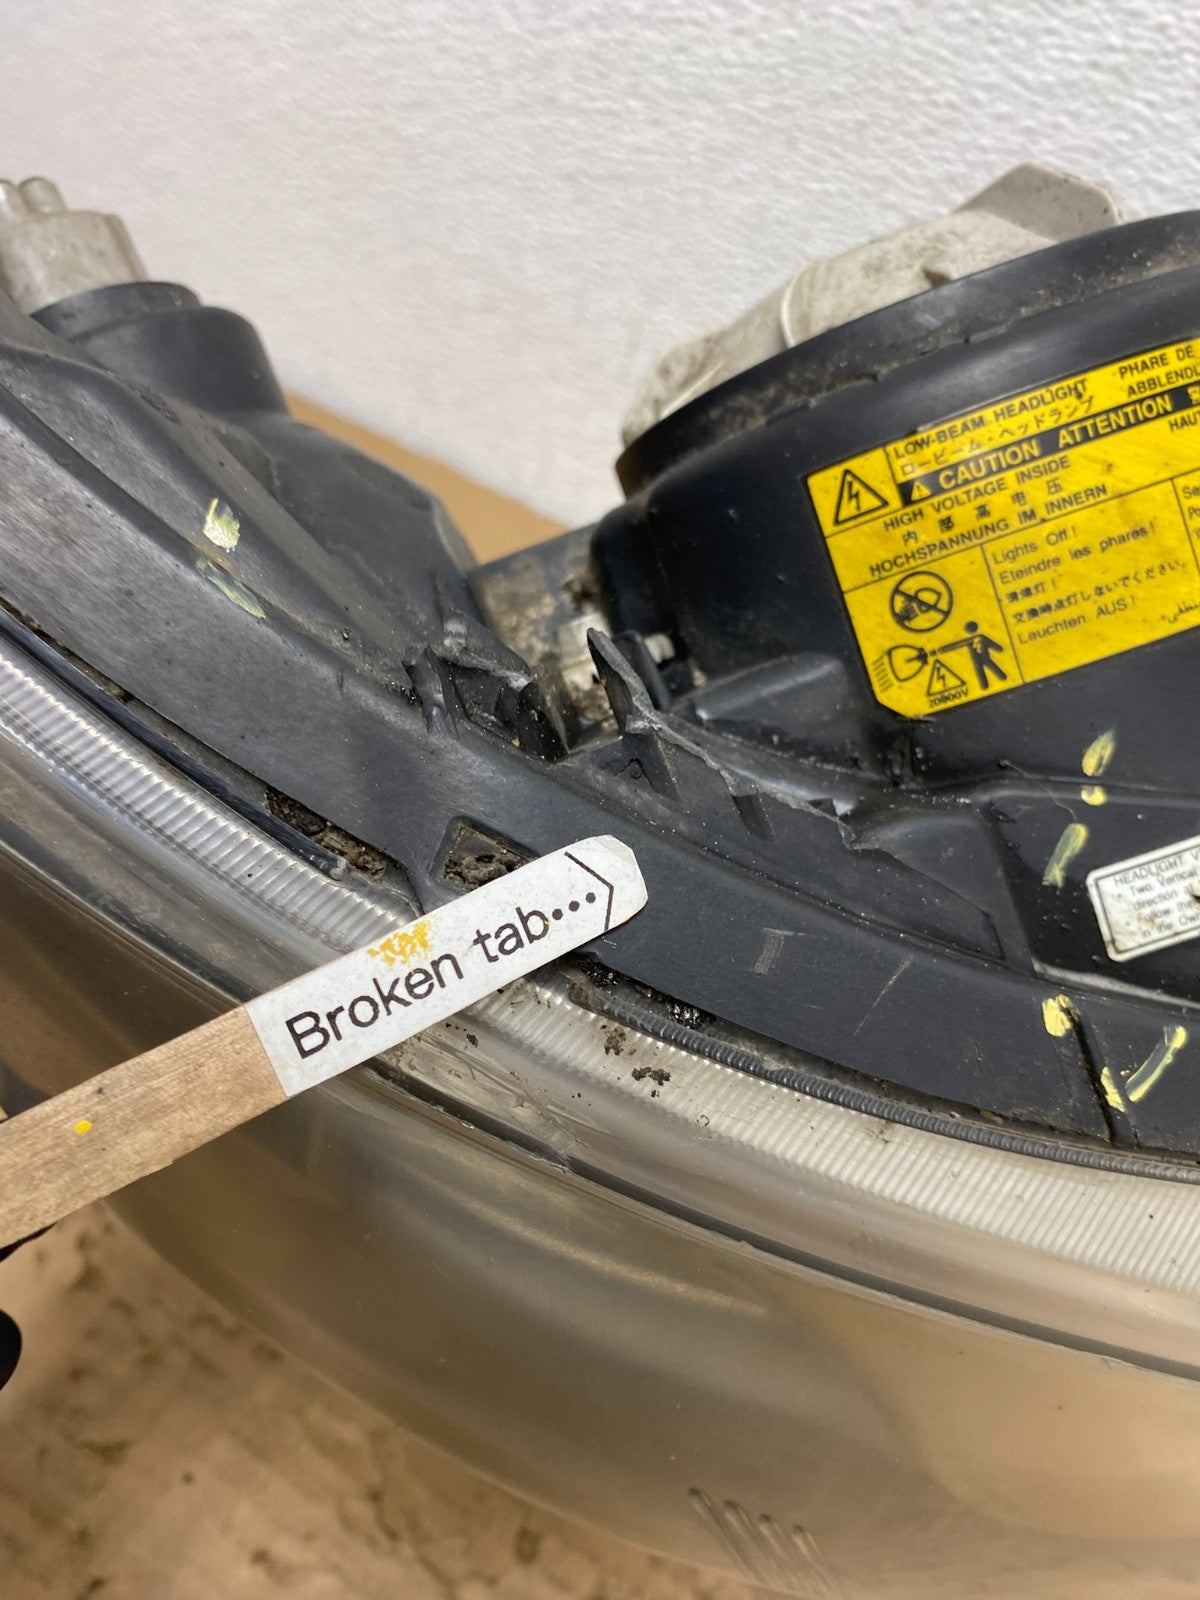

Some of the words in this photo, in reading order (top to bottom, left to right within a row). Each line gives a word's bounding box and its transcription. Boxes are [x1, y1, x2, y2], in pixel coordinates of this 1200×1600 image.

[1119, 352, 1169, 378] PHARE
[1175, 344, 1194, 361] DE
[894, 415, 985, 459] LOW-BEAM
[993, 379, 1087, 422] HEADLIGHT
[938, 438, 1041, 490] CAUTION
[1058, 394, 1173, 449] ATTENTION
[883, 508, 924, 532] HIGH
[931, 477, 1008, 513] VOLTAGE
[1015, 455, 1071, 484] INSIDE
[869, 518, 1010, 577] HOCHSPANNUNG
[1017, 507, 1037, 525] IM
[1045, 484, 1107, 515] INNERN
[992, 541, 1038, 565] Lights
[999, 556, 1061, 584] Eteindre
[1069, 546, 1092, 560] les
[1018, 614, 1087, 645] Leuchten
[1131, 883, 1152, 897] Two
[285, 953, 464, 1059] Broken
